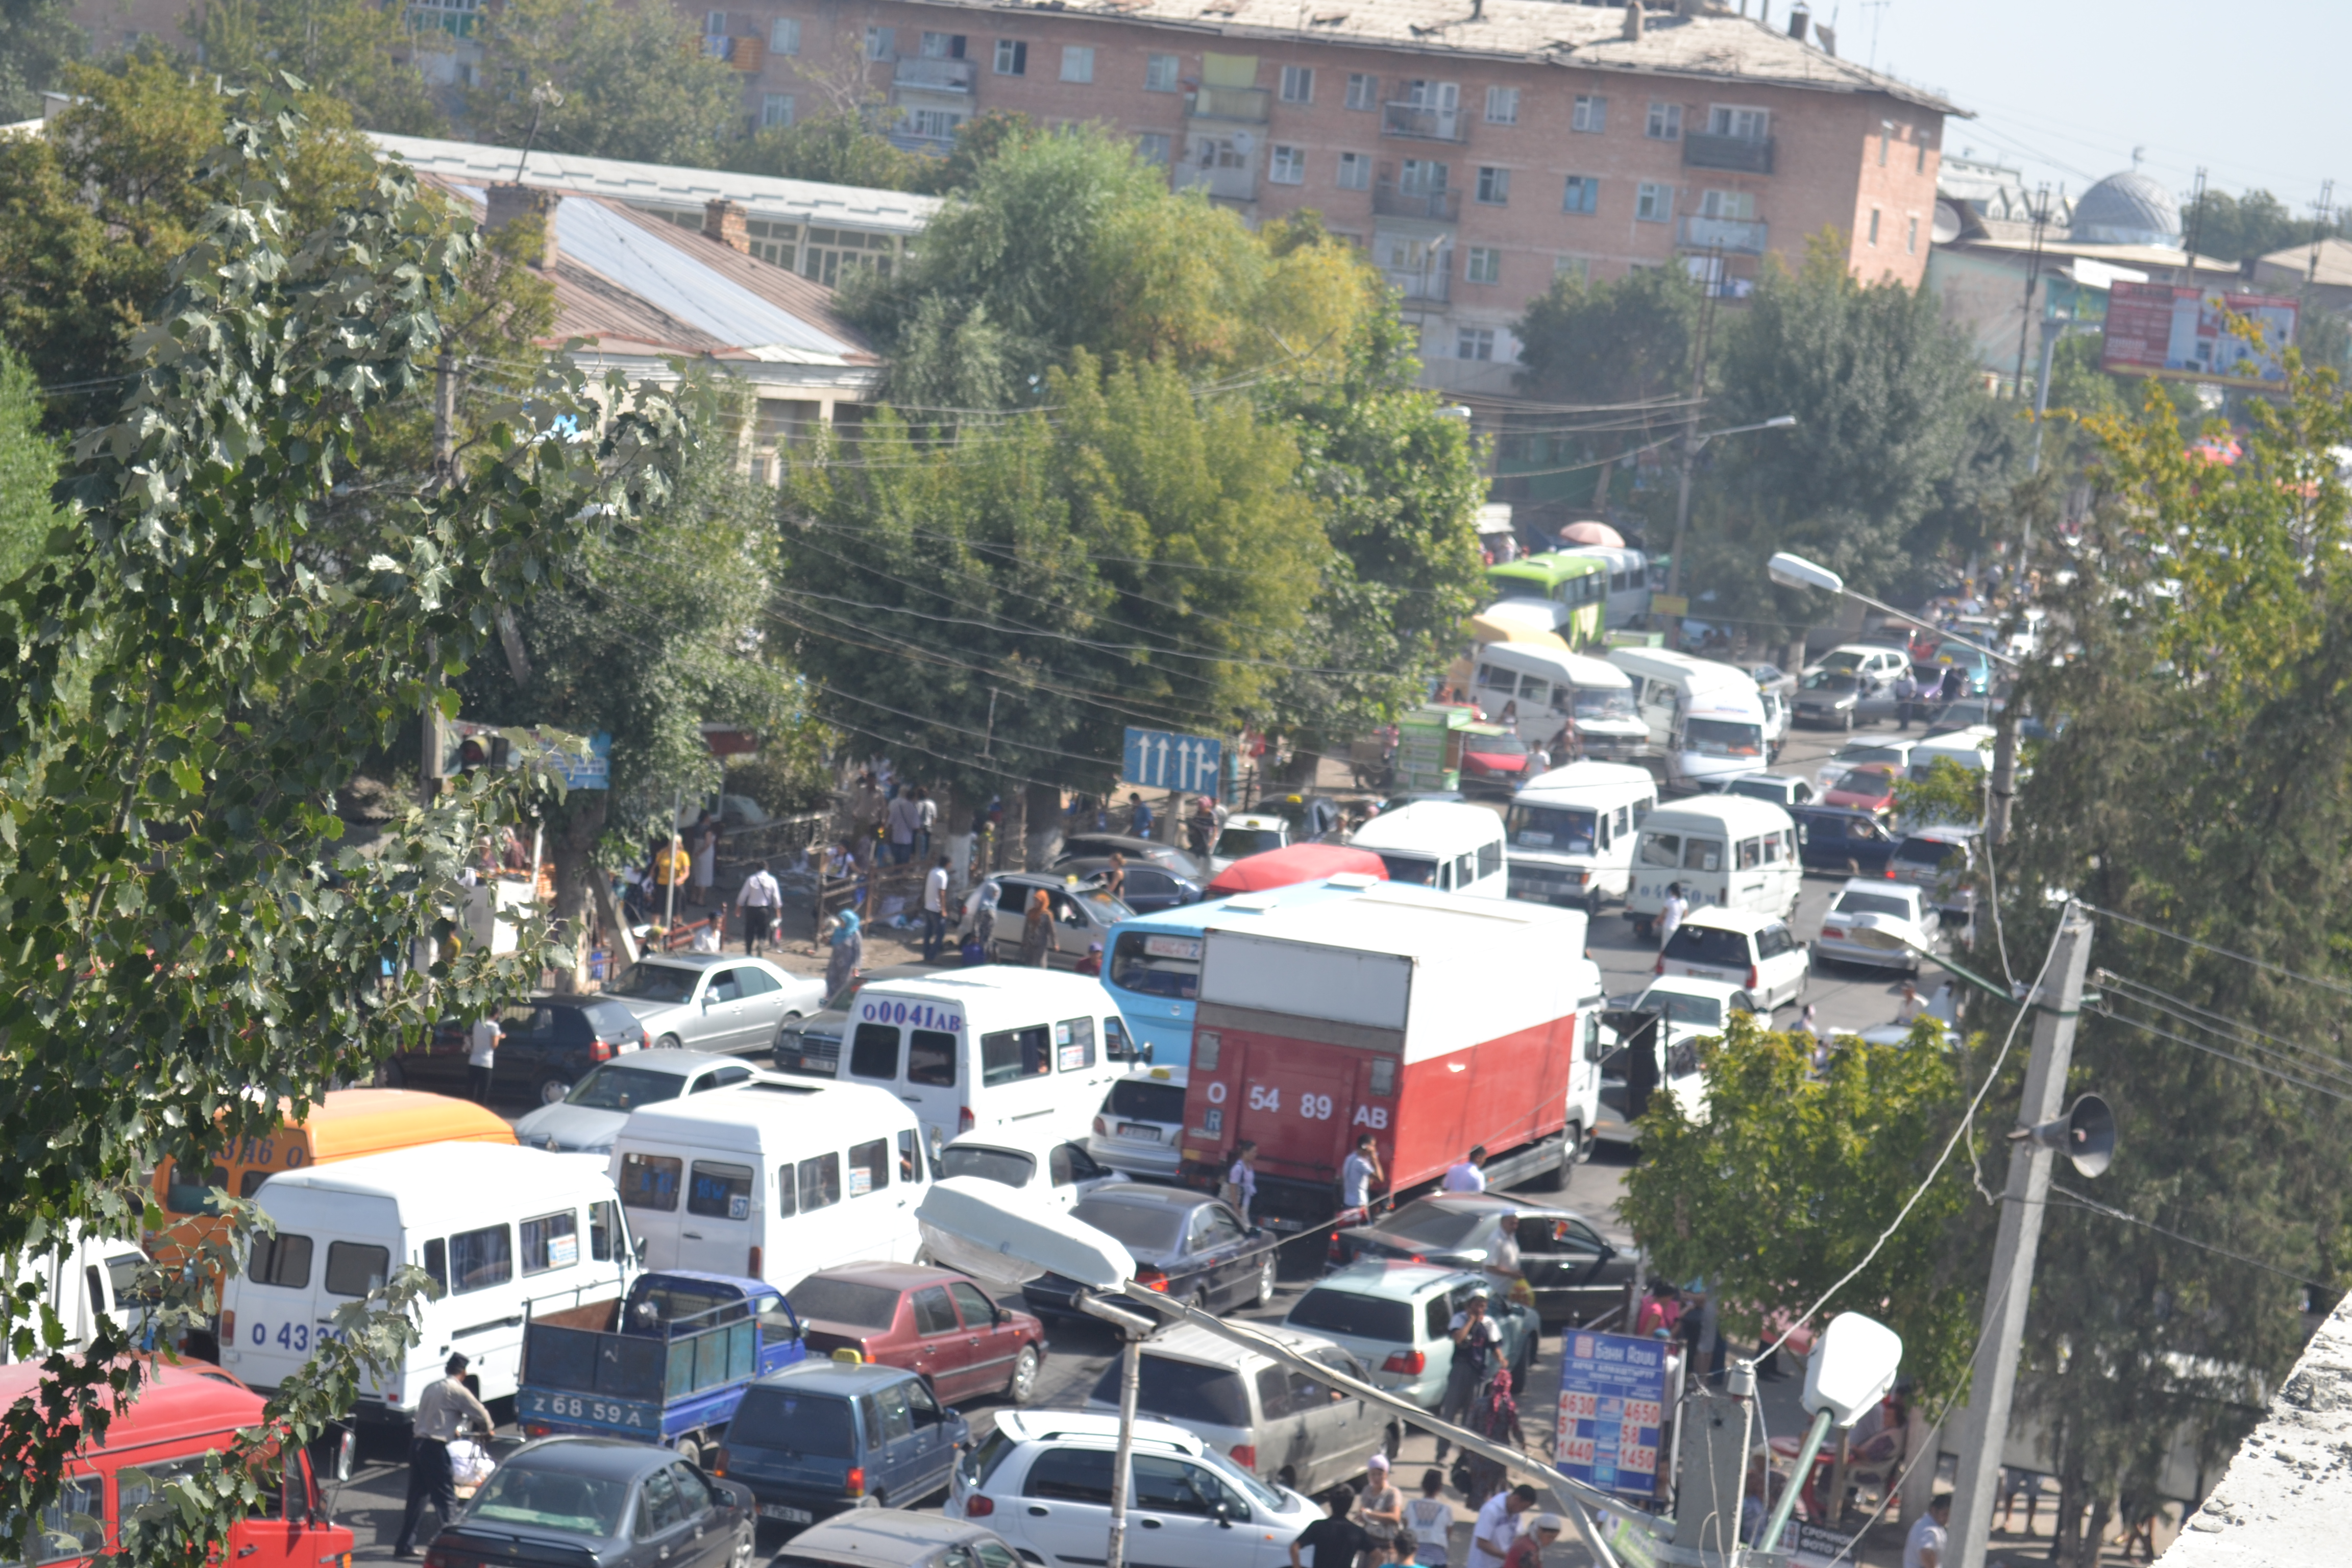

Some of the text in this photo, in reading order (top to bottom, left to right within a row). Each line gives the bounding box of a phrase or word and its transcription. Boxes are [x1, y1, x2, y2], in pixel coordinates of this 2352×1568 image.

[1248, 1086, 1280, 1113] 54
[1300, 1093, 1333, 1120] 89
[1353, 1105, 1388, 1130] AB
[552, 1396, 582, 1418] 68
[592, 1403, 621, 1424] 59
[626, 1411, 642, 1427] A
[1560, 1394, 1596, 1416] 4630
[1624, 1402, 1658, 1424] 4650
[1558, 1416, 1577, 1436] 57
[1559, 1440, 1594, 1461] 1440
[1622, 1448, 1655, 1469] 1450
